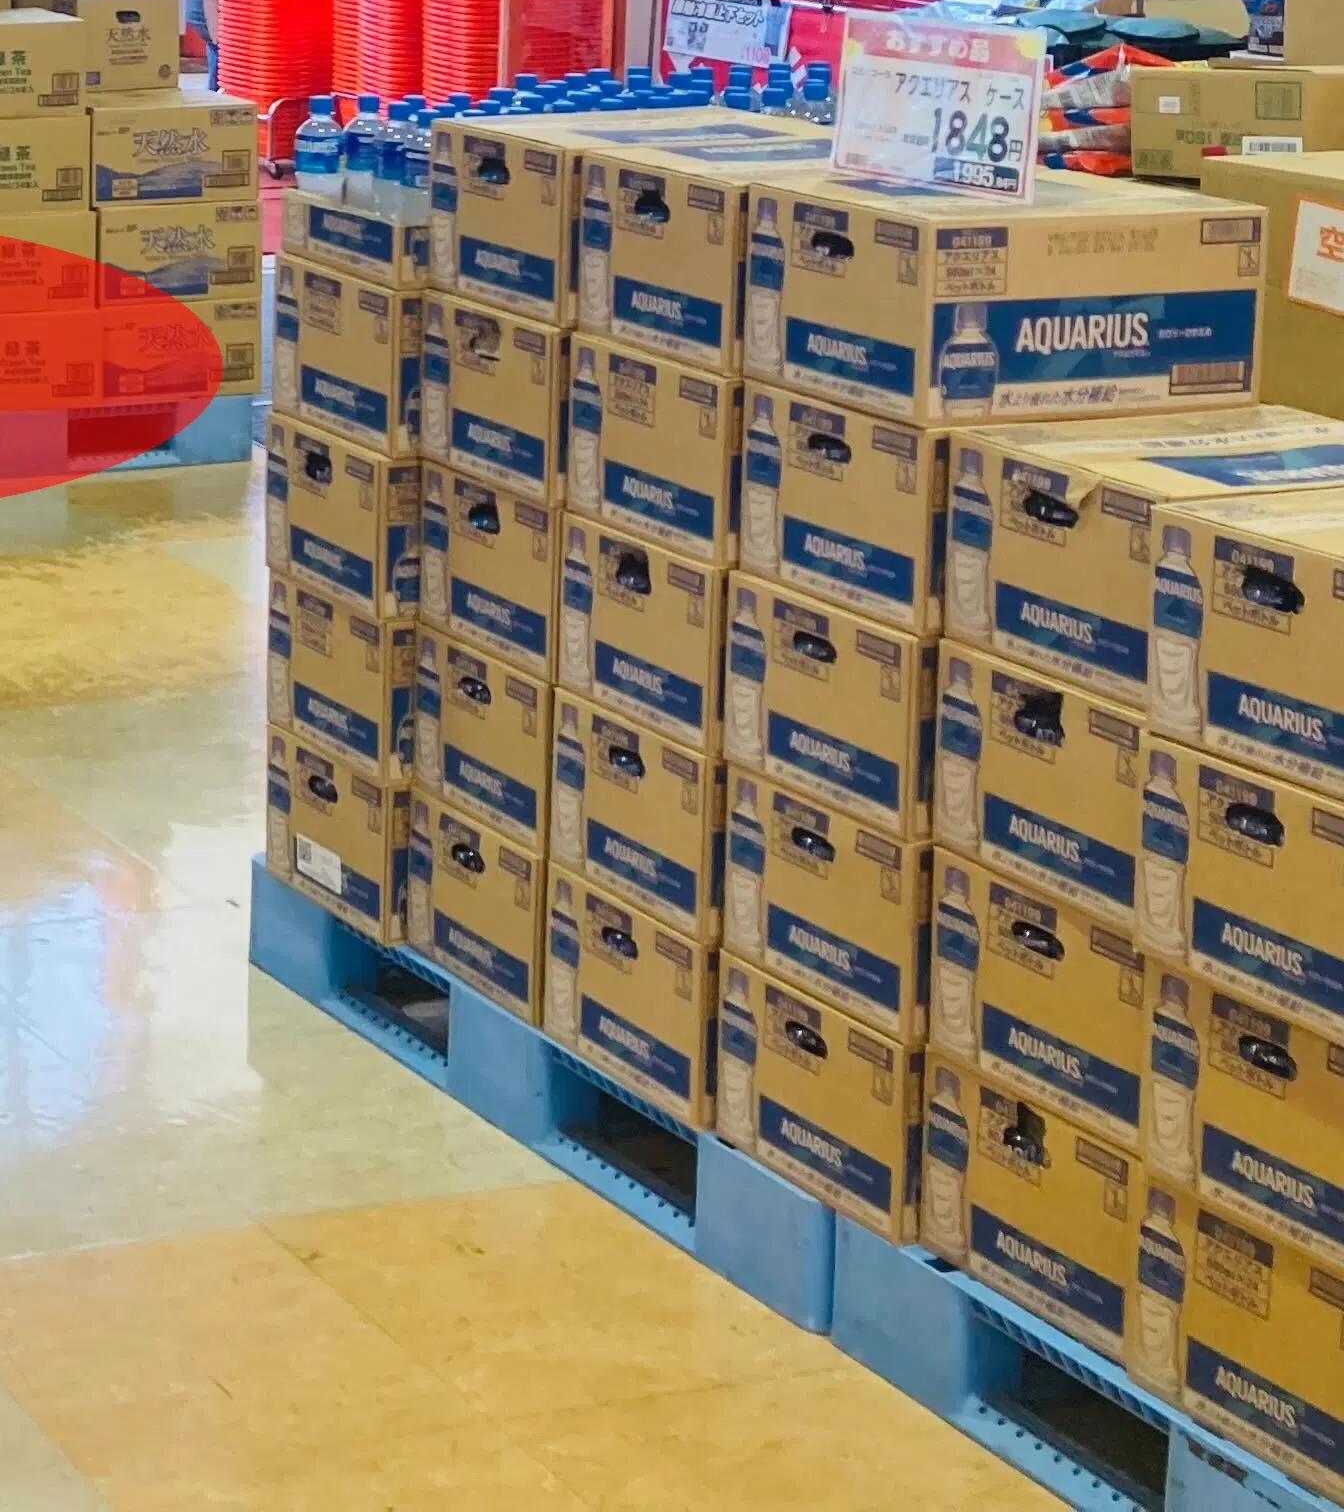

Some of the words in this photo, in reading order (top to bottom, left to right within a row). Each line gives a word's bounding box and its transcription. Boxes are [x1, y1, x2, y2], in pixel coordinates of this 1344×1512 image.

[885, 29, 990, 63] おすすめ品
[15, 67, 32, 76] Tea
[894, 72, 972, 103] アクエリアス
[985, 85, 1025, 110] ケース
[132, 127, 210, 157] 天然水
[19, 162, 36, 171] Tea
[631, 288, 682, 319] AQUARIUS
[807, 332, 868, 366] AQUARIUS
[1016, 312, 1151, 355] AQUARIUS
[623, 475, 674, 509] AQUARIUS
[804, 533, 866, 571] AQUARIUS
[1156, 576, 1203, 603] AQUARIUS
[1021, 601, 1094, 644] AQUARIUS
[613, 658, 664, 698] AQUARIUS
[1238, 693, 1325, 742] AQUARIUS
[789, 731, 853, 772] AQUARIUS
[604, 836, 656, 878] AQUARIUS
[1009, 813, 1081, 863] AQUARIUS
[789, 924, 853, 973] AQUARIUS
[1221, 921, 1303, 976] AQUARIUS
[1008, 1027, 1082, 1080] AQUARIUS
[780, 1118, 843, 1169] AQUARIUS
[1232, 1150, 1316, 1209] AQUARIUS
[996, 1231, 1070, 1287] AQUARIUS
[1215, 1365, 1298, 1428] AQUARIUS
